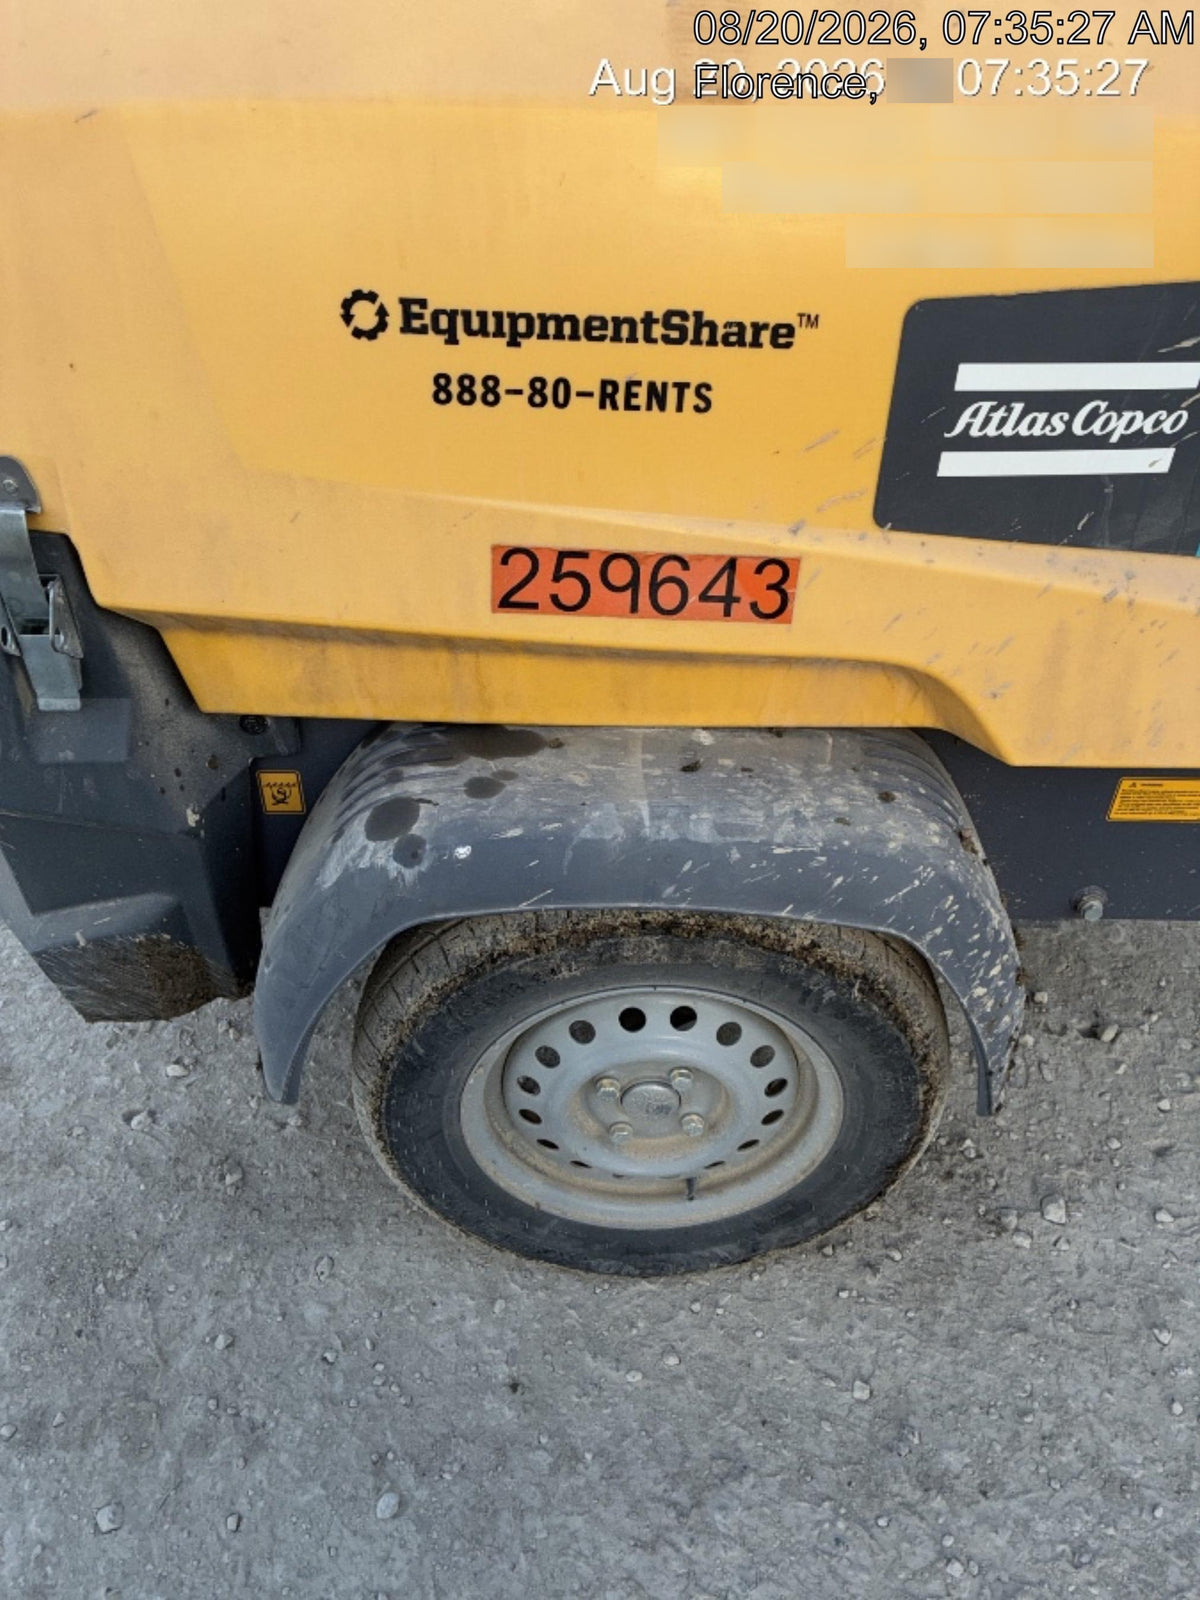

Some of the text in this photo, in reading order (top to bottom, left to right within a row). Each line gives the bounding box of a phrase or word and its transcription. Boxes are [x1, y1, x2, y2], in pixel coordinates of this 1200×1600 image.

[432, 372, 714, 415] 888-80-RENTS
[943, 400, 1189, 444] Atlas Copco
[497, 546, 791, 620] 259643
